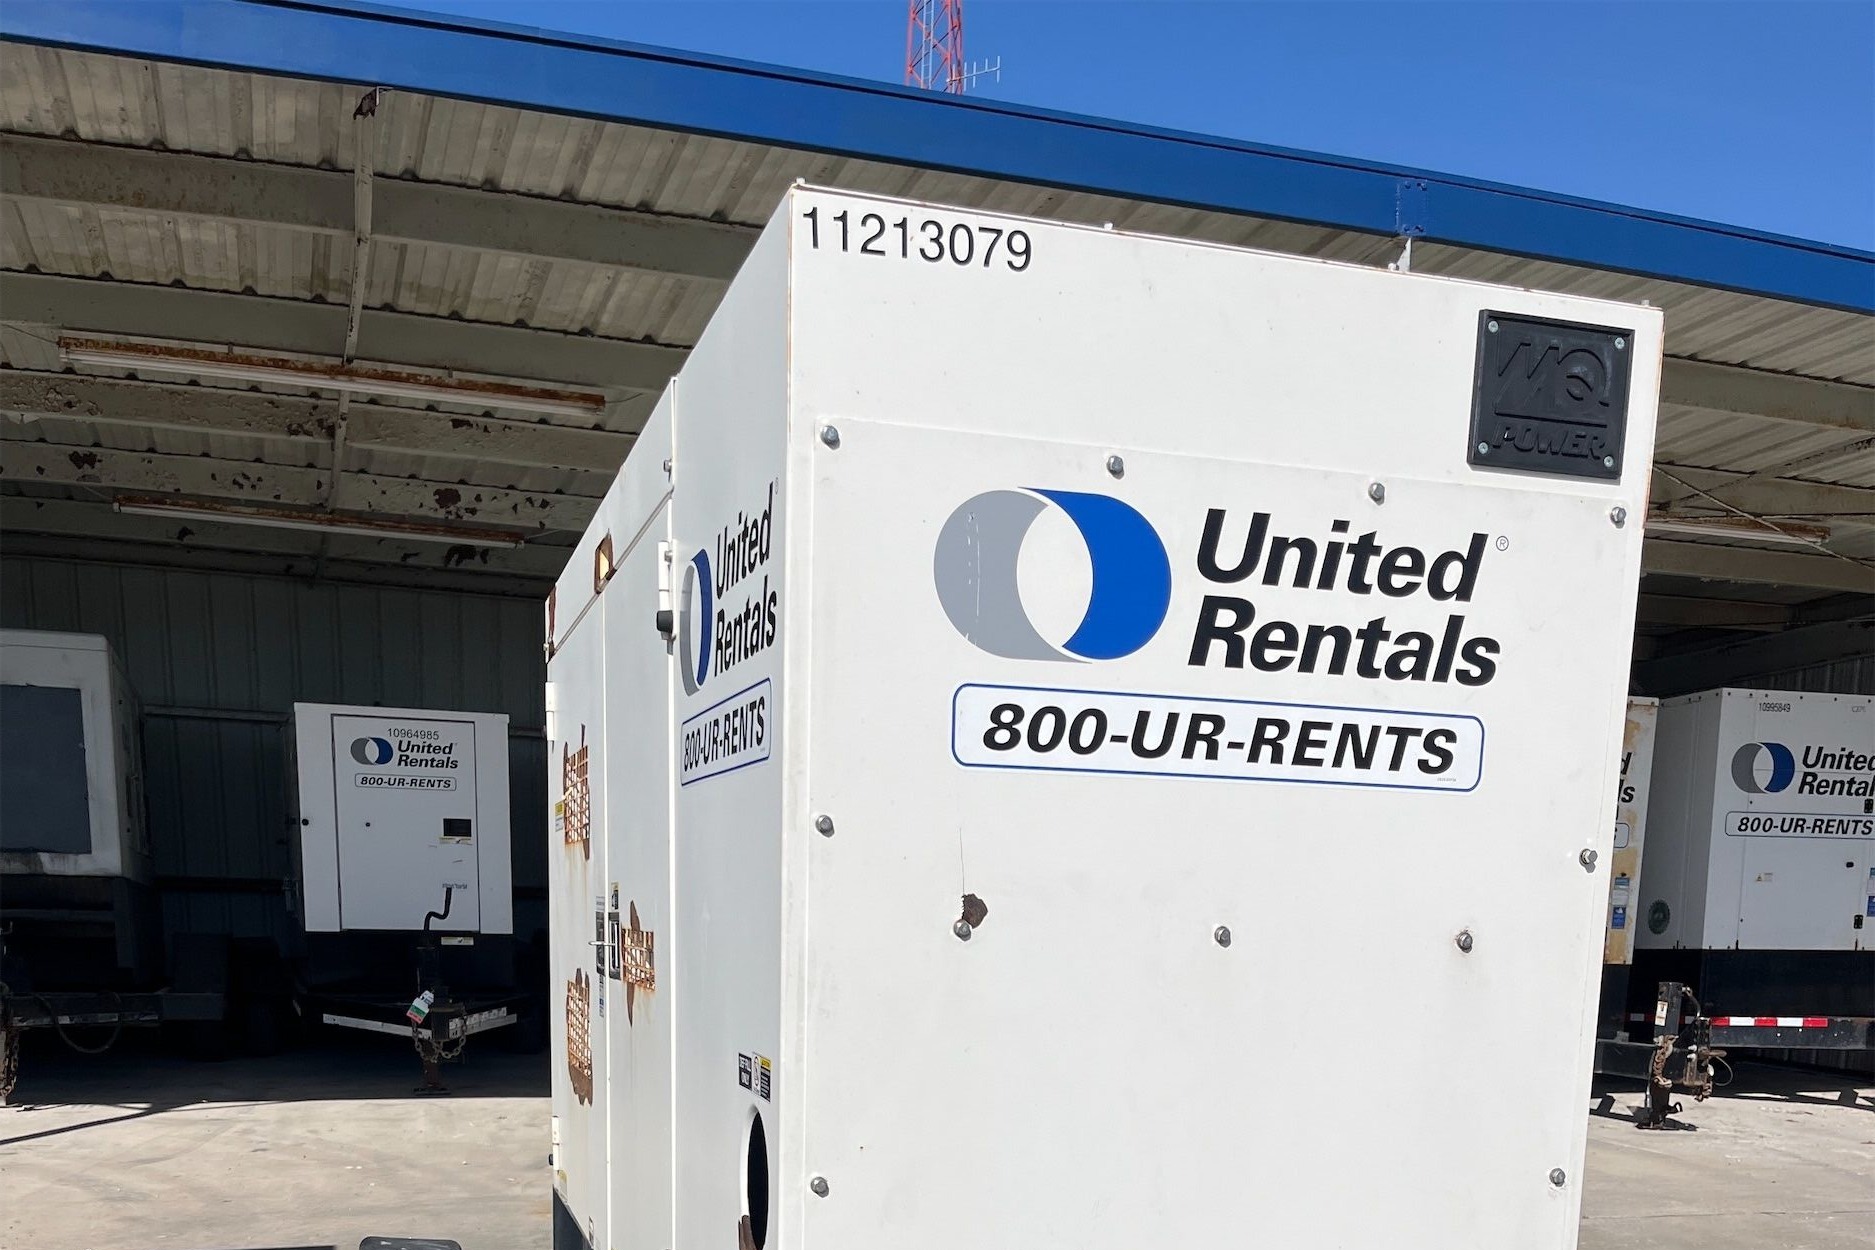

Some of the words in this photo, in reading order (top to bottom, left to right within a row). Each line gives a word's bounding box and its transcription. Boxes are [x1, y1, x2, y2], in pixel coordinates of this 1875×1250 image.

[804, 206, 1033, 272] 11213079
[1492, 424, 1606, 460] POWER
[716, 481, 774, 600] United
[1197, 508, 1489, 603] United
[714, 574, 777, 678] Rentals
[1188, 595, 1501, 687] Rentals
[387, 728, 440, 740] 10964985
[397, 740, 453, 755] United
[397, 754, 459, 769] Rentals
[684, 696, 765, 772] 800-UR-RENTS
[982, 702, 1458, 775] 800-UR-RENTS
[360, 776, 451, 789] 800-UR-RENTS
[1737, 816, 1874, 836] 800-UR-RENTS
